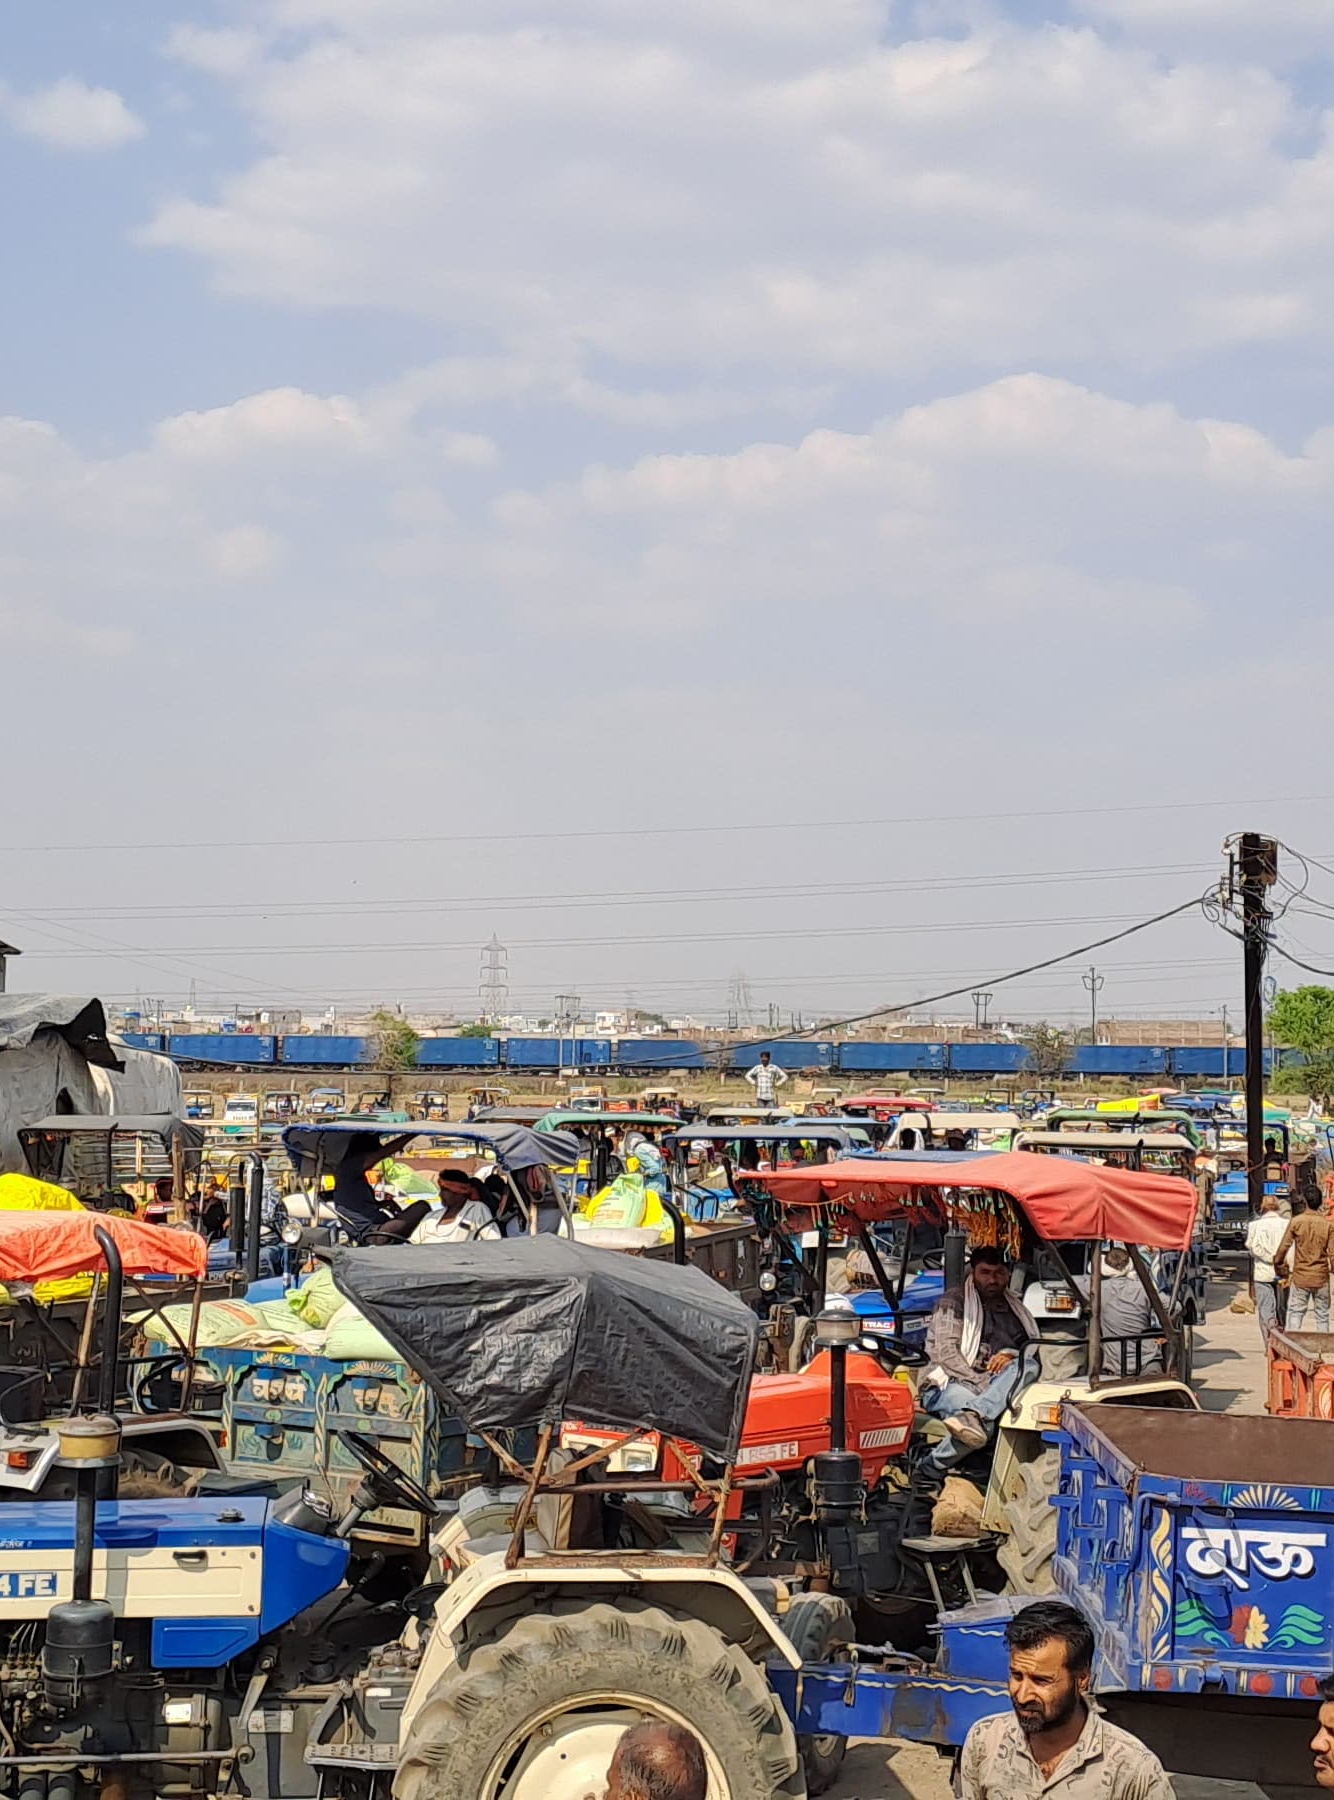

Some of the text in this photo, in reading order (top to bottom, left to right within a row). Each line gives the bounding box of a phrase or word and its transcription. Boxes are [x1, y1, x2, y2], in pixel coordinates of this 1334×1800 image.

[780, 1442, 797, 1459] FE
[1181, 1527, 1327, 1589] दाऊ
[18, 1573, 53, 1596] FE
